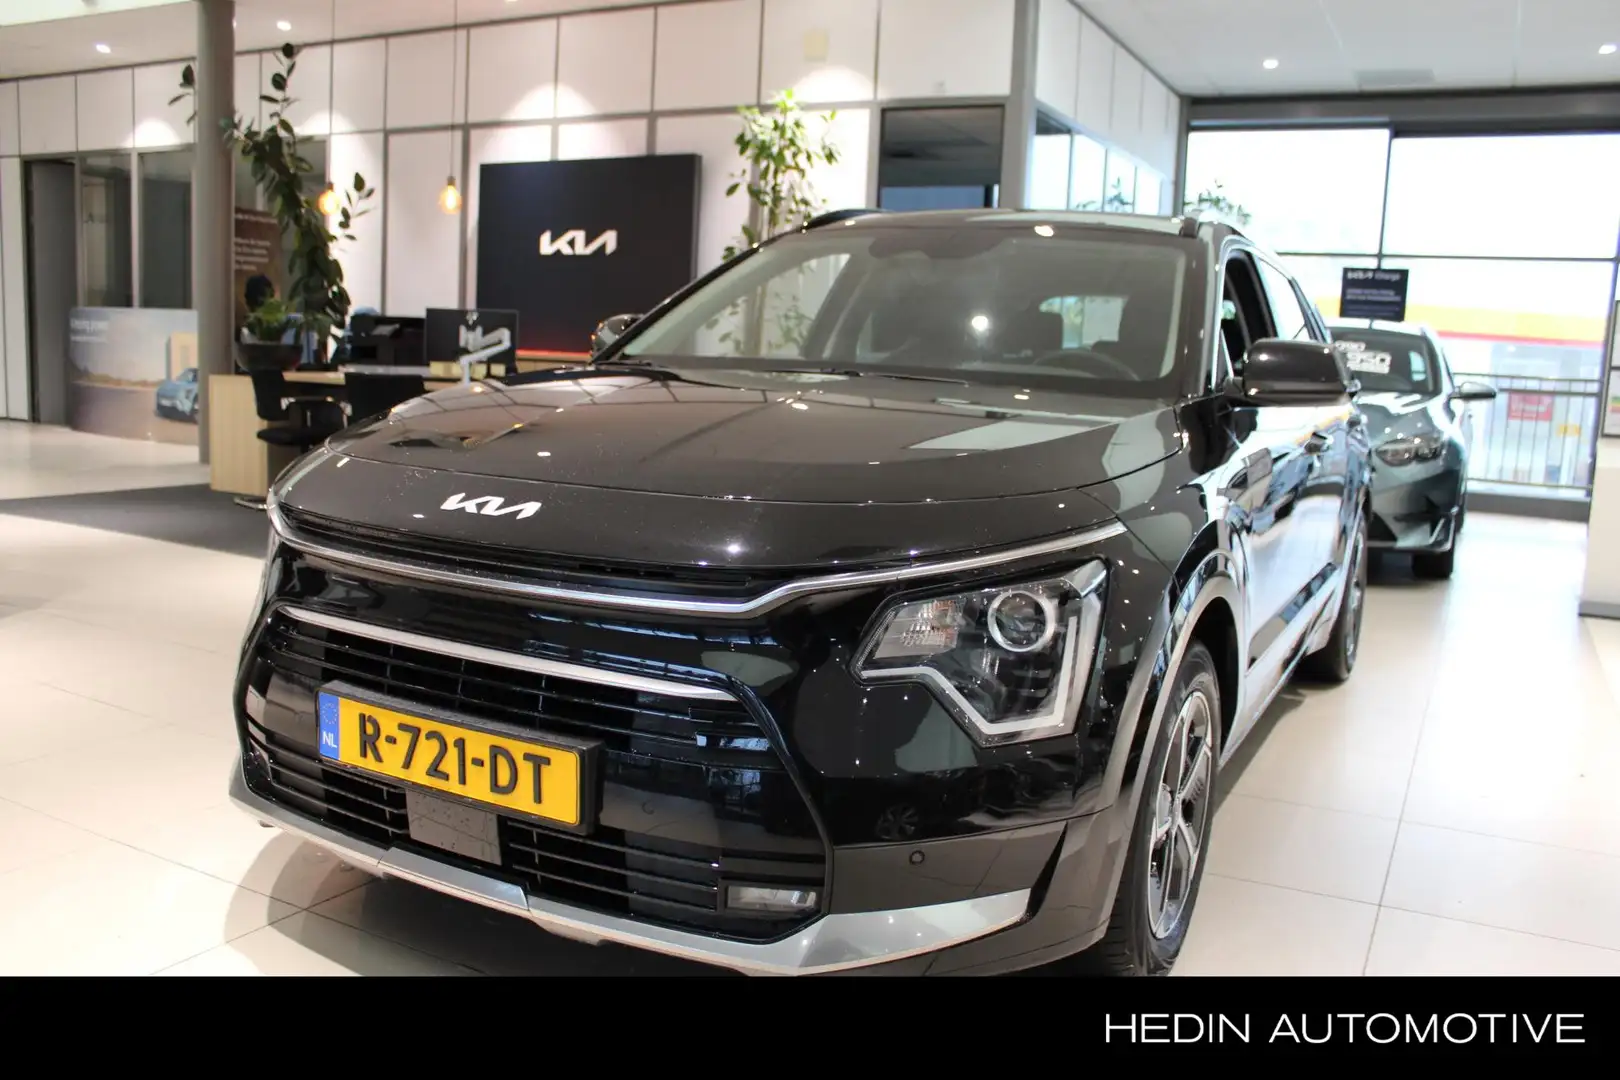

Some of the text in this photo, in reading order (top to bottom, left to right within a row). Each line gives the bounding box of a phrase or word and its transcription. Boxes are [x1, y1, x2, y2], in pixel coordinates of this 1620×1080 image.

[539, 229, 618, 256] KIA
[440, 492, 542, 520] KIA
[322, 731, 338, 748] NL
[358, 712, 551, 804] R-721-DT
